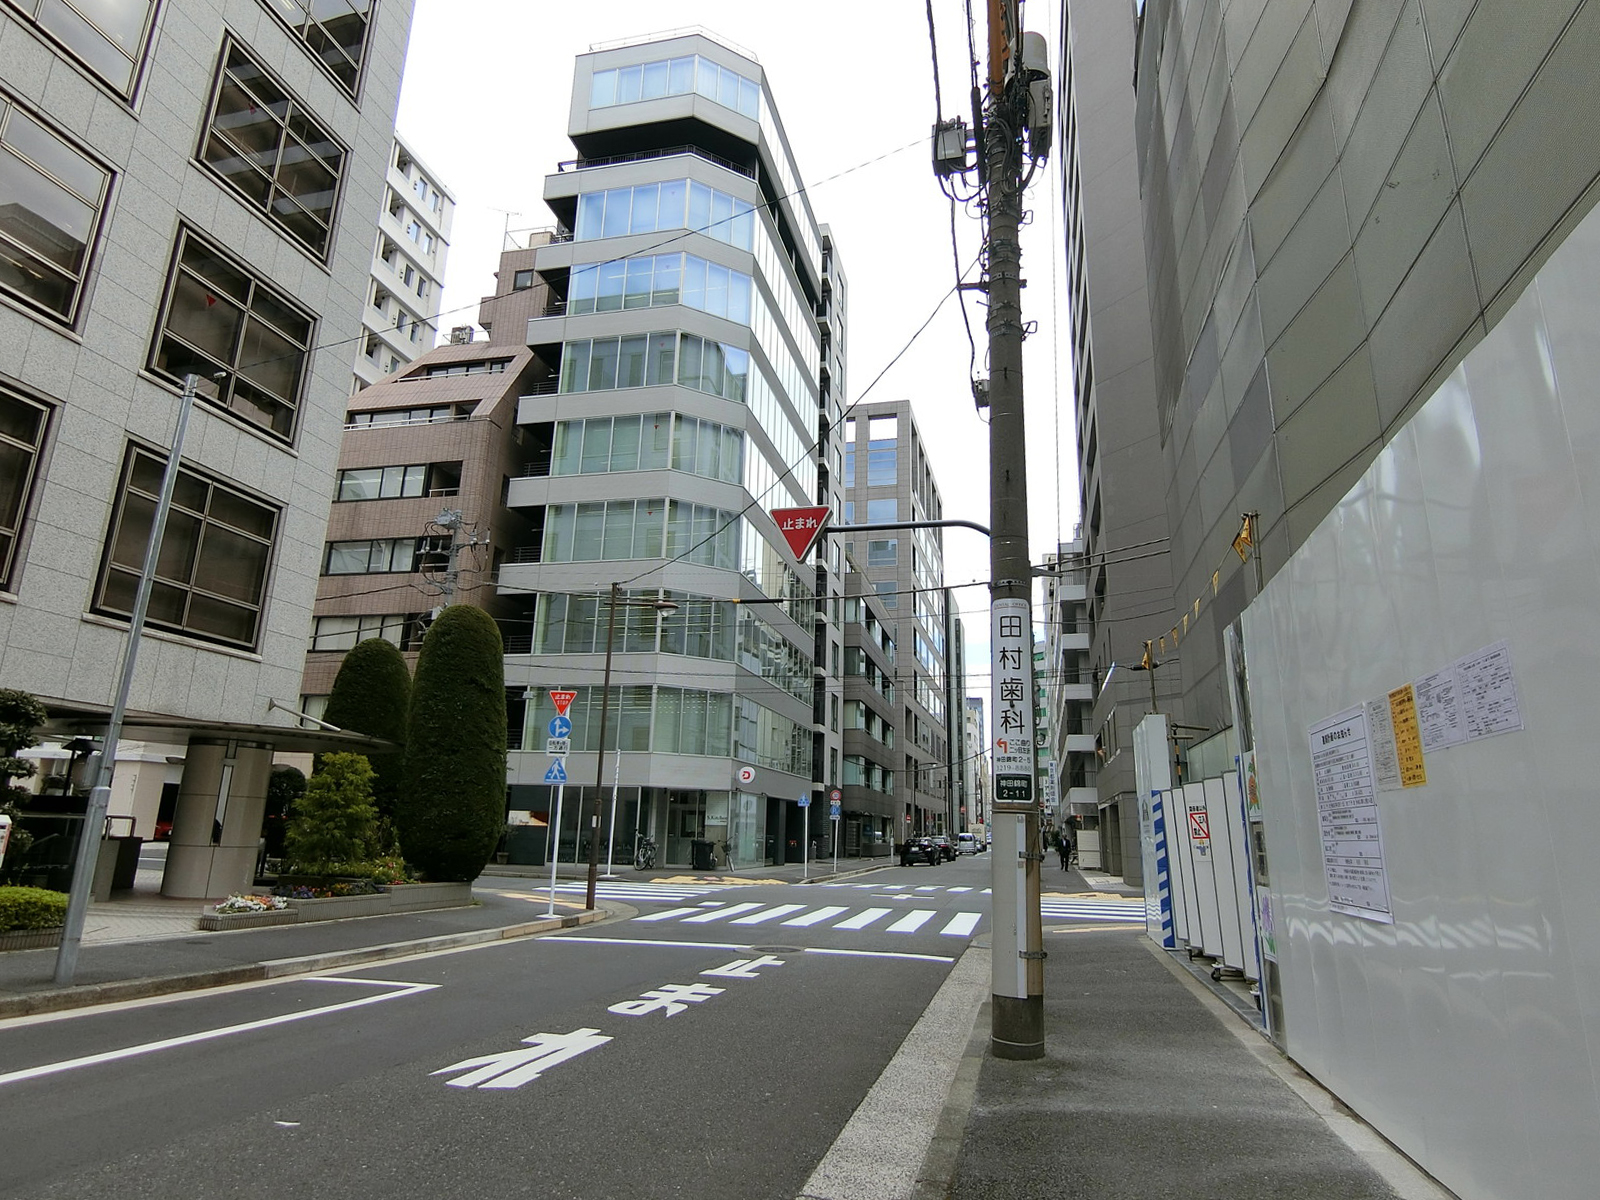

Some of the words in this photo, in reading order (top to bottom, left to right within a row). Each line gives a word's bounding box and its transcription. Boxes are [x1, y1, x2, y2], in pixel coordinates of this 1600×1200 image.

[782, 516, 818, 531] 止まれ
[999, 615, 1025, 735] 田村歯科
[1000, 779, 1028, 788] 神田錦町
[1002, 789, 1026, 798] 2-11
[428, 955, 785, 1089] 止まれ
